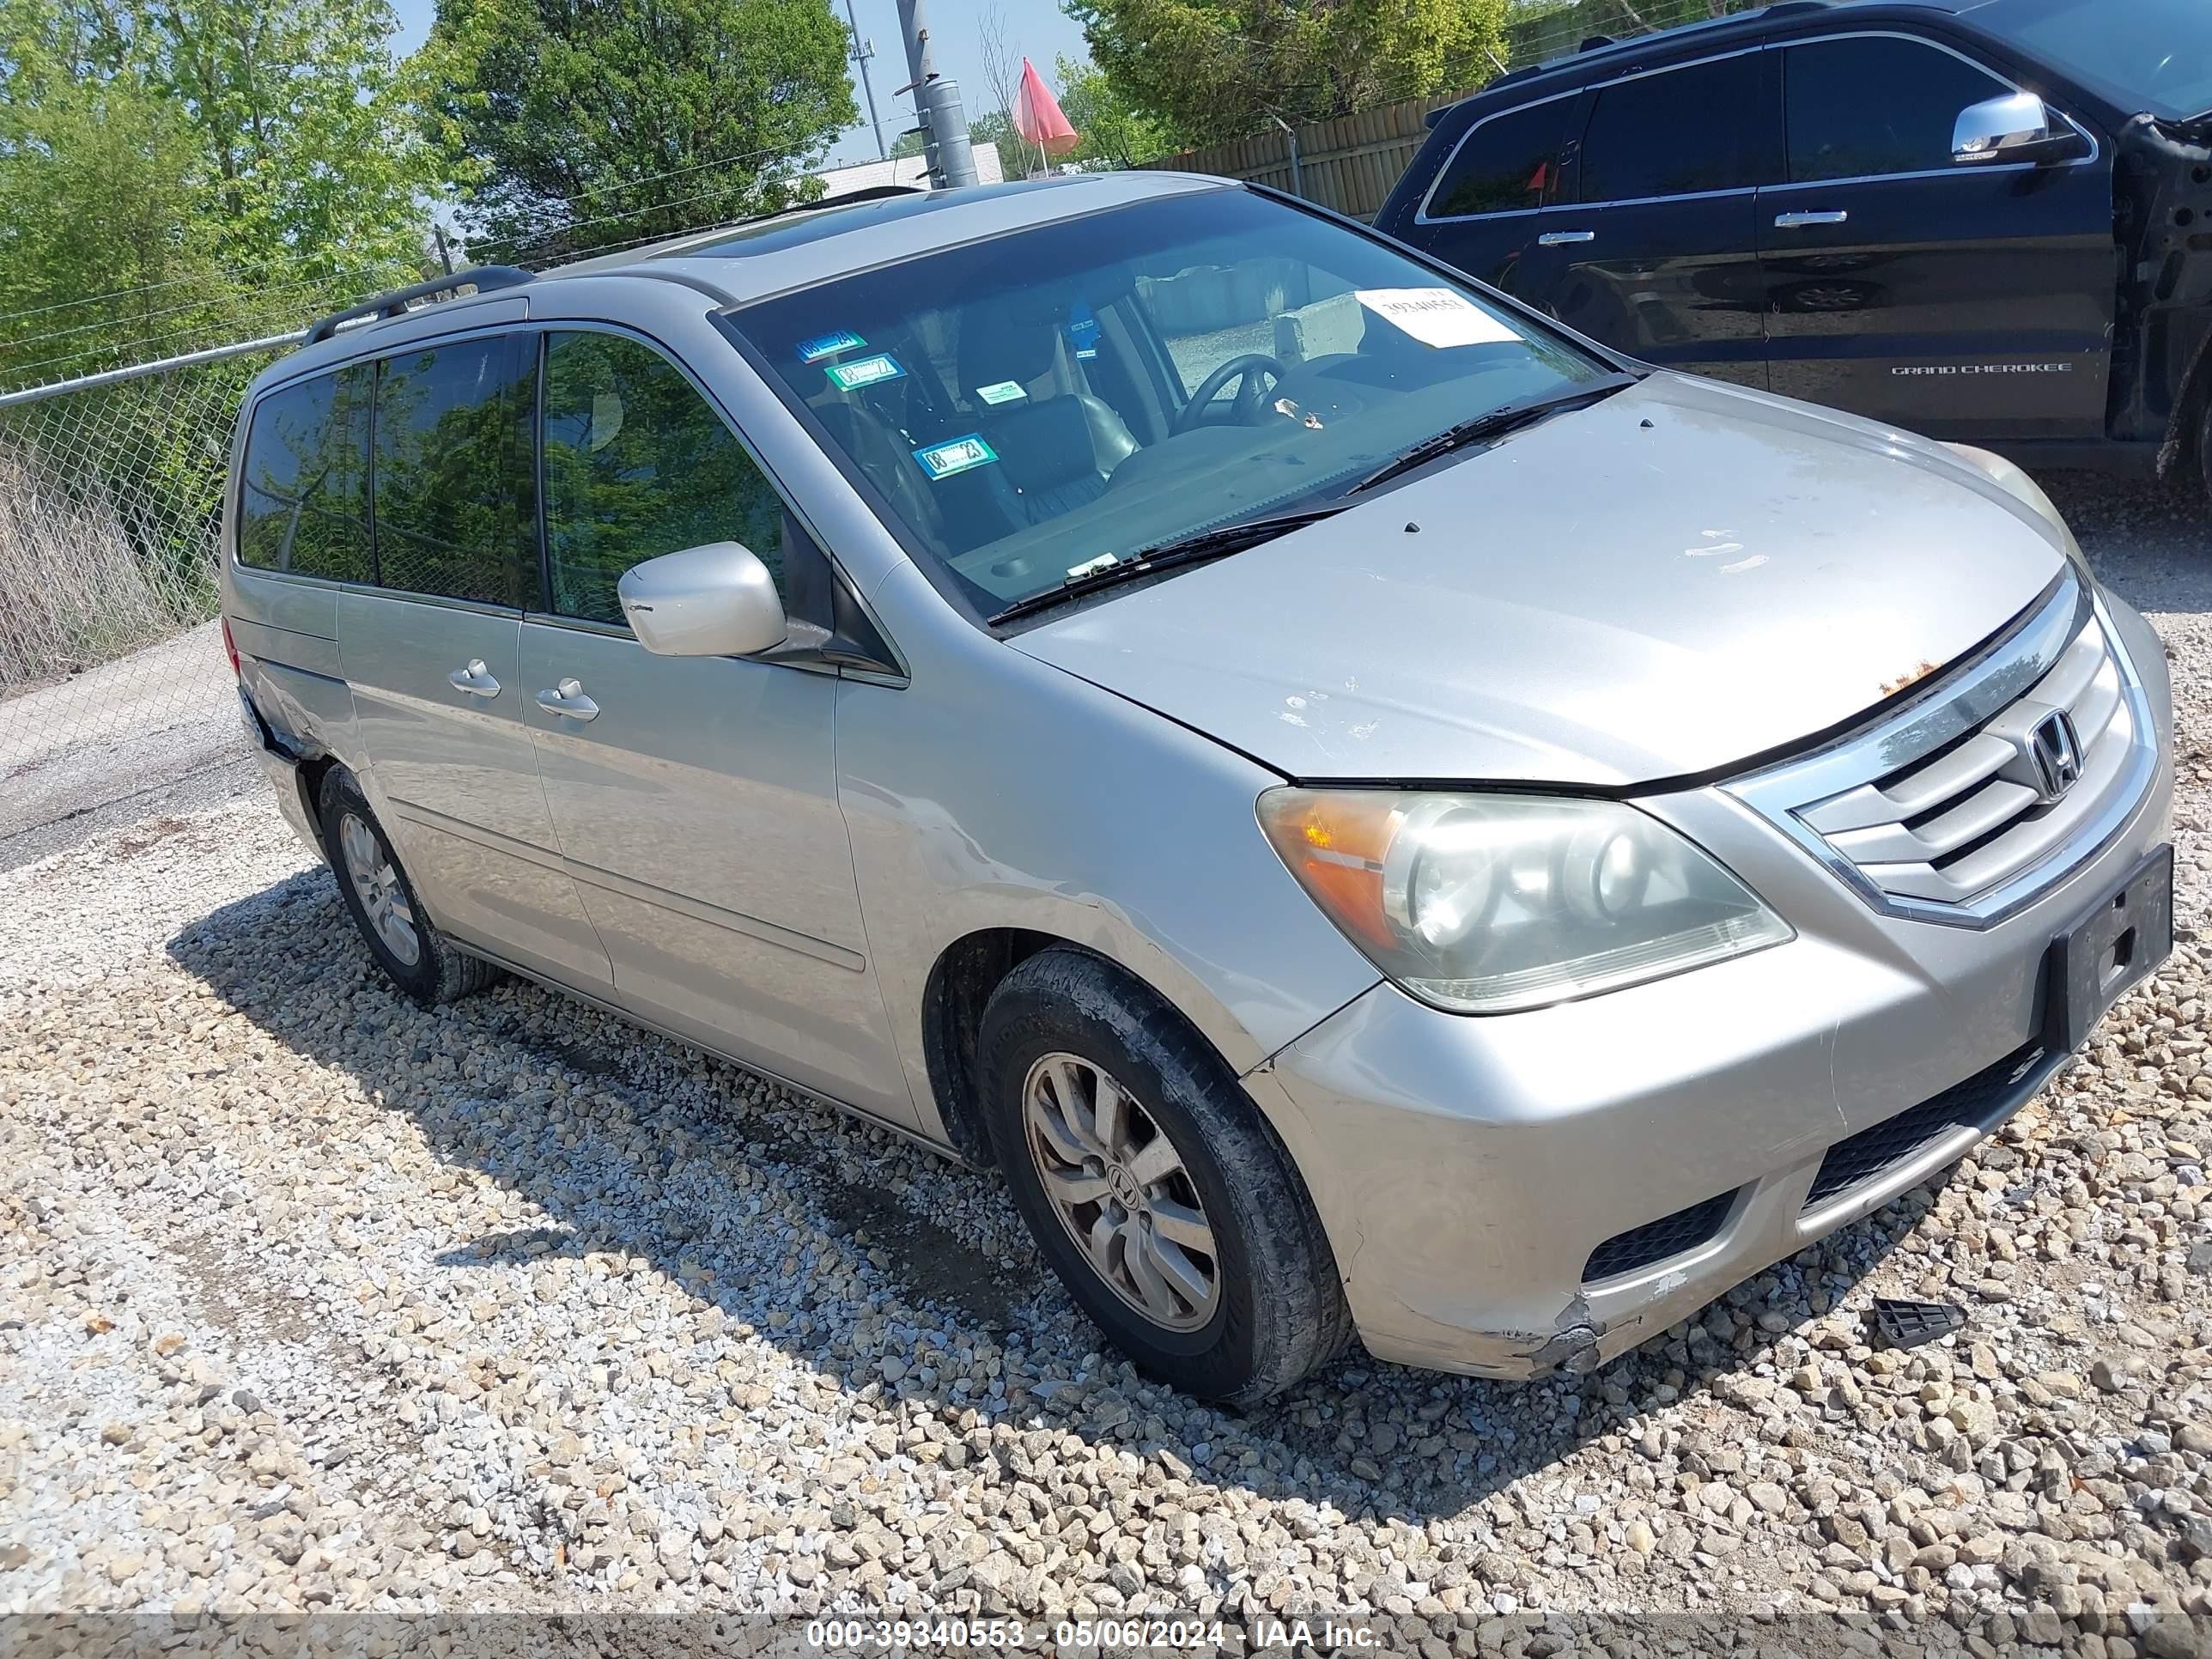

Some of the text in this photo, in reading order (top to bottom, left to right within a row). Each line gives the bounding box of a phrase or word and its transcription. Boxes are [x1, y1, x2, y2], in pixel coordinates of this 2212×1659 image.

[1382, 299, 1465, 315] 39340553
[801, 331, 853, 355] 08 24
[837, 368, 860, 383] 08
[1891, 362, 2073, 375] GRAND CHEROKEE
[925, 451, 948, 471] 08
[959, 441, 981, 460] 23
